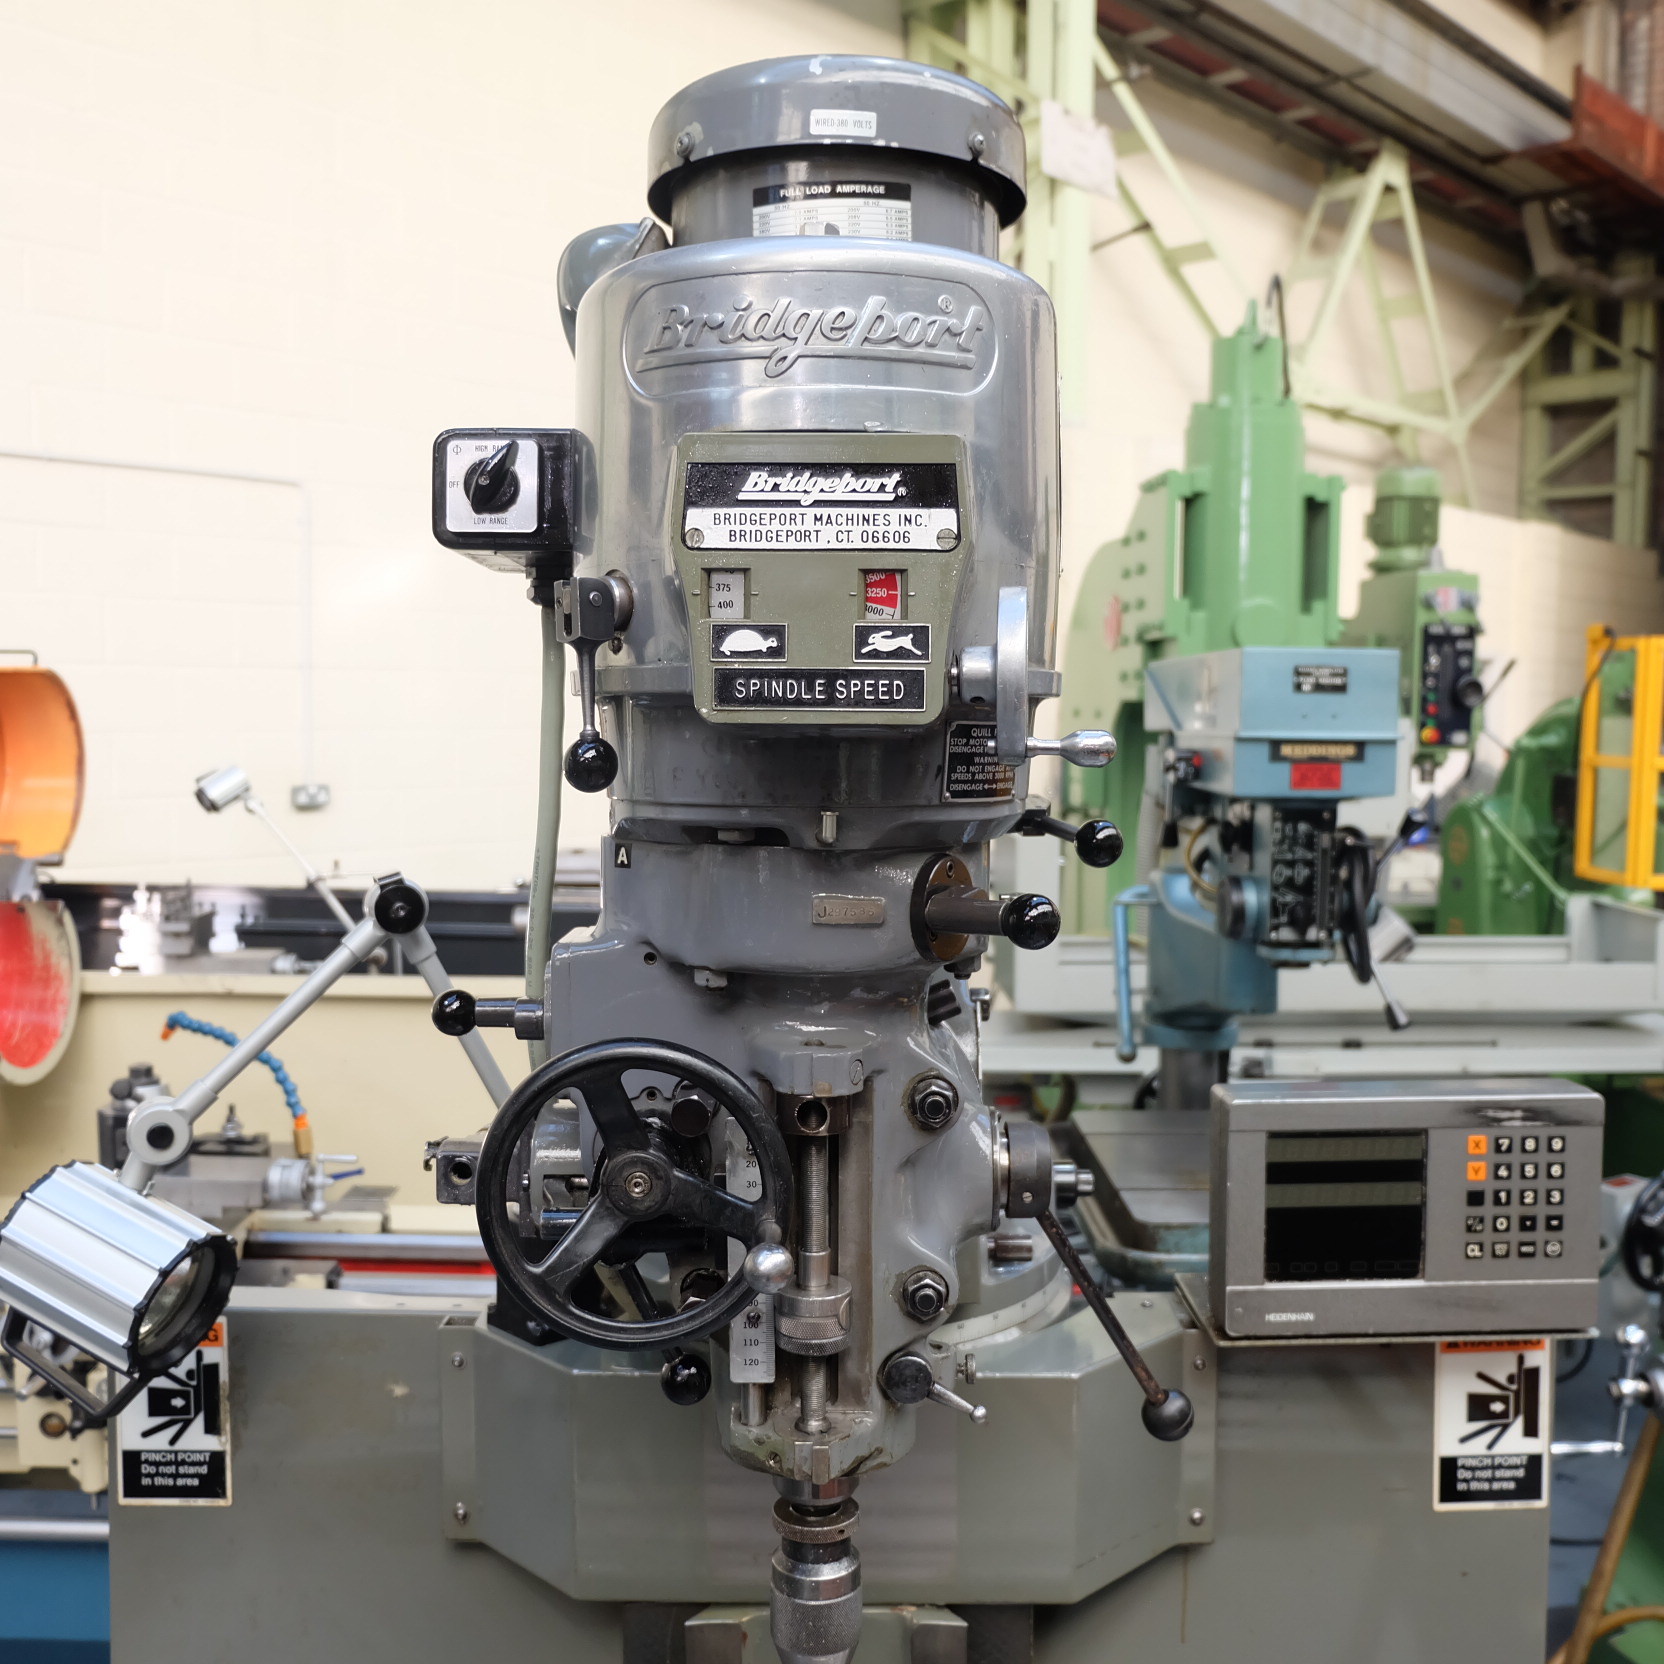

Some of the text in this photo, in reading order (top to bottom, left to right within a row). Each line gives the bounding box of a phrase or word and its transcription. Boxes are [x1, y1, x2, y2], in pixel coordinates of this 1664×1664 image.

[852, 120, 873, 130] VOLTS
[780, 184, 886, 198] FULL LOAD AMPERAGE
[645, 295, 984, 379] Bridgeport
[448, 481, 460, 489] OFF
[740, 471, 902, 506] Bridgeport
[713, 512, 928, 528] BRIDGEPORT MACHINES INC.
[835, 530, 854, 544] CT.
[860, 530, 912, 545] 06606
[715, 582, 731, 593] 375
[866, 587, 888, 598] 3250
[717, 599, 734, 610] 400
[735, 679, 905, 700] SPINDLE SPEED
[971, 727, 991, 737] QUILL
[956, 765, 967, 773] DO
[984, 764, 1005, 772] ENGAGE
[951, 773, 972, 781] SPEEDS
[949, 781, 1013, 791] DISENGAGE ENGAGE
[616, 846, 629, 866] A
[1472, 1137, 1564, 1152] X 7 8 9
[745, 1160, 757, 1168] 20
[1471, 1163, 1562, 1179] Y 4 5 6
[746, 1180, 757, 1188] 30
[1498, 1189, 1561, 1205] 1 2 3
[1495, 1216, 1508, 1231] 0
[1466, 1244, 1483, 1258] CL
[1265, 1312, 1315, 1322] HEIDENHAIN
[743, 1338, 760, 1347] 110
[743, 1358, 760, 1366] 120
[140, 1452, 211, 1462] PINCH POINT
[1456, 1455, 1529, 1468] PINCH POINT
[140, 1464, 209, 1475] Do not stand
[1456, 1467, 1525, 1480] Do not stand
[141, 1476, 200, 1486] in this area
[1456, 1480, 1516, 1492] in this area
